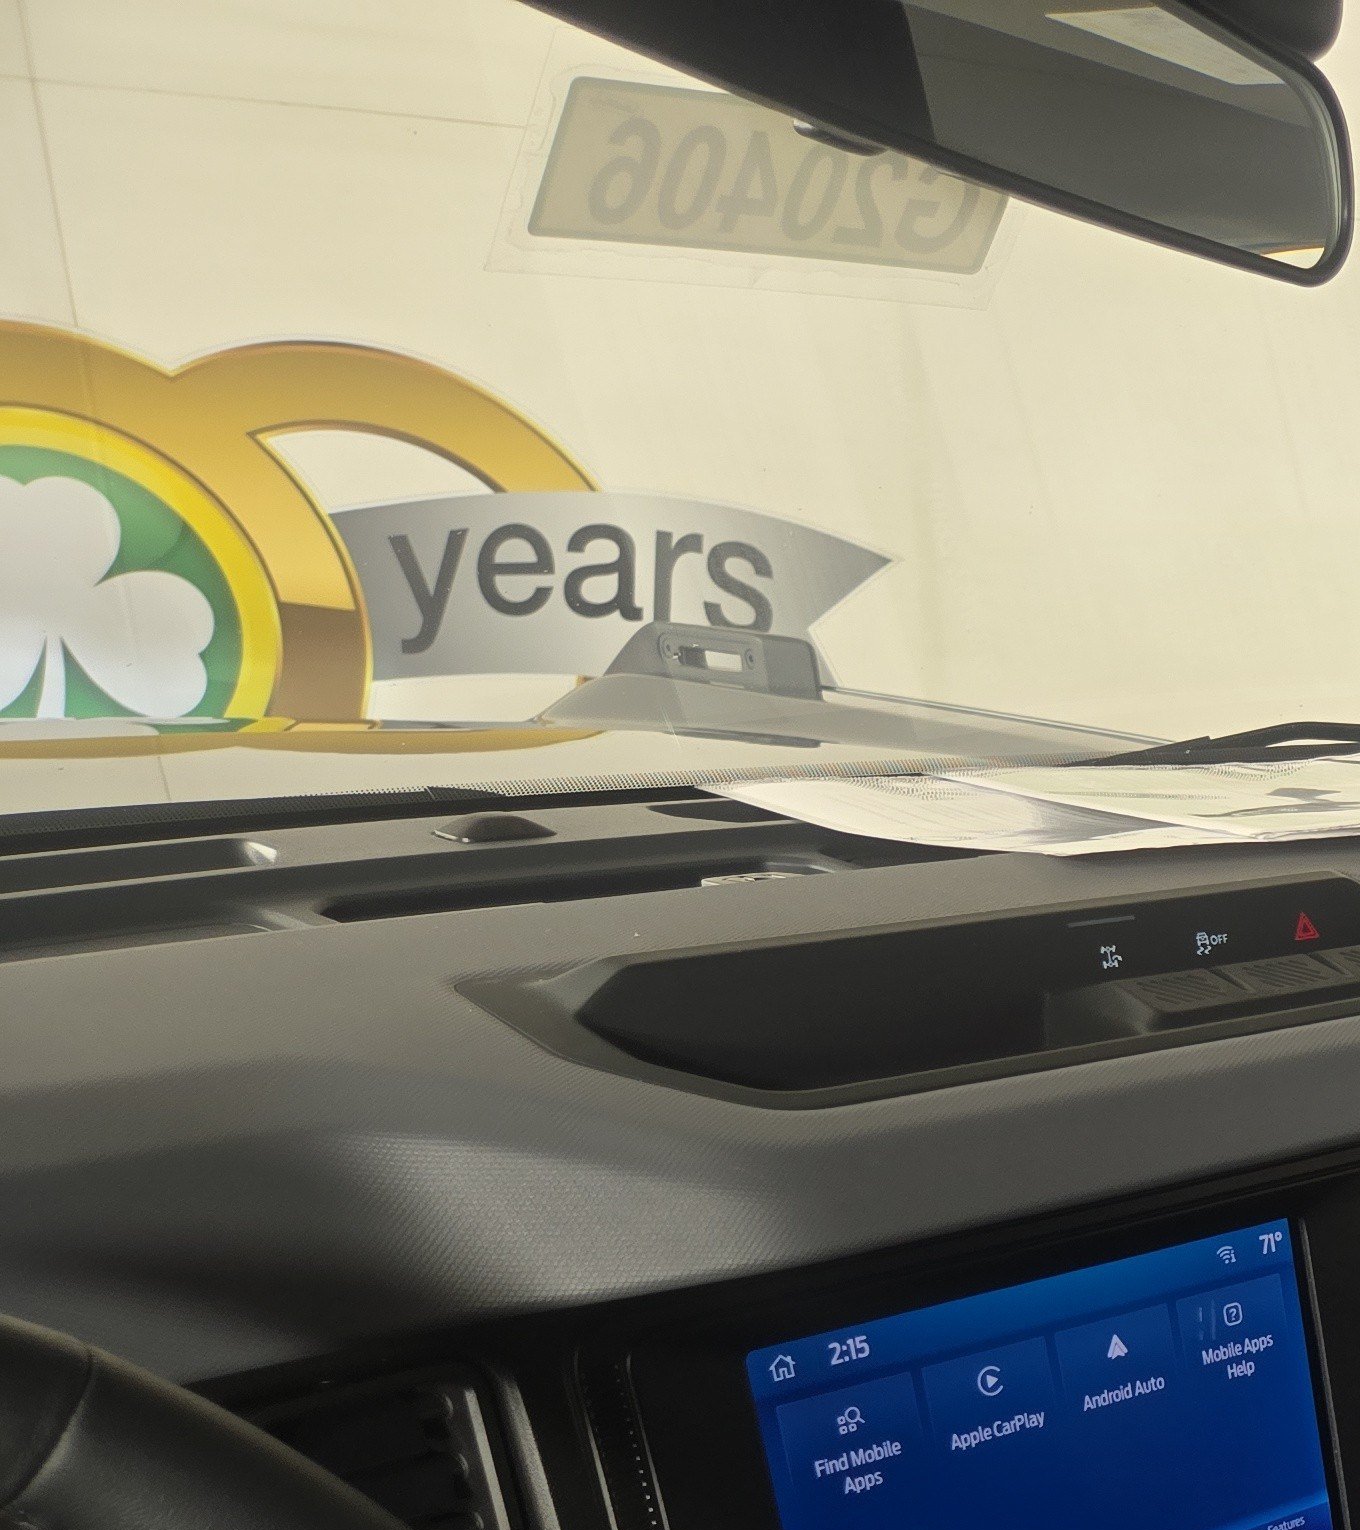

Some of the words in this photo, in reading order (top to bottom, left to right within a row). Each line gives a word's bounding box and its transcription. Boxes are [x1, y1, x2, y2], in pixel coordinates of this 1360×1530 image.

[387, 522, 774, 655] years
[1209, 933, 1228, 946] OFF
[1258, 1231, 1284, 1256] 71°
[827, 1334, 871, 1367] 2:15
[1202, 1341, 1242, 1366] Mobile
[1243, 1333, 1274, 1358] Apps
[1226, 1358, 1256, 1381] Help
[1082, 1381, 1133, 1412] Android
[1134, 1374, 1166, 1398] Auto
[950, 1423, 994, 1453] Apple
[994, 1409, 1046, 1442] CarPlay
[814, 1451, 849, 1479] Find
[850, 1436, 902, 1471] Mobile
[843, 1469, 884, 1497] Apps
